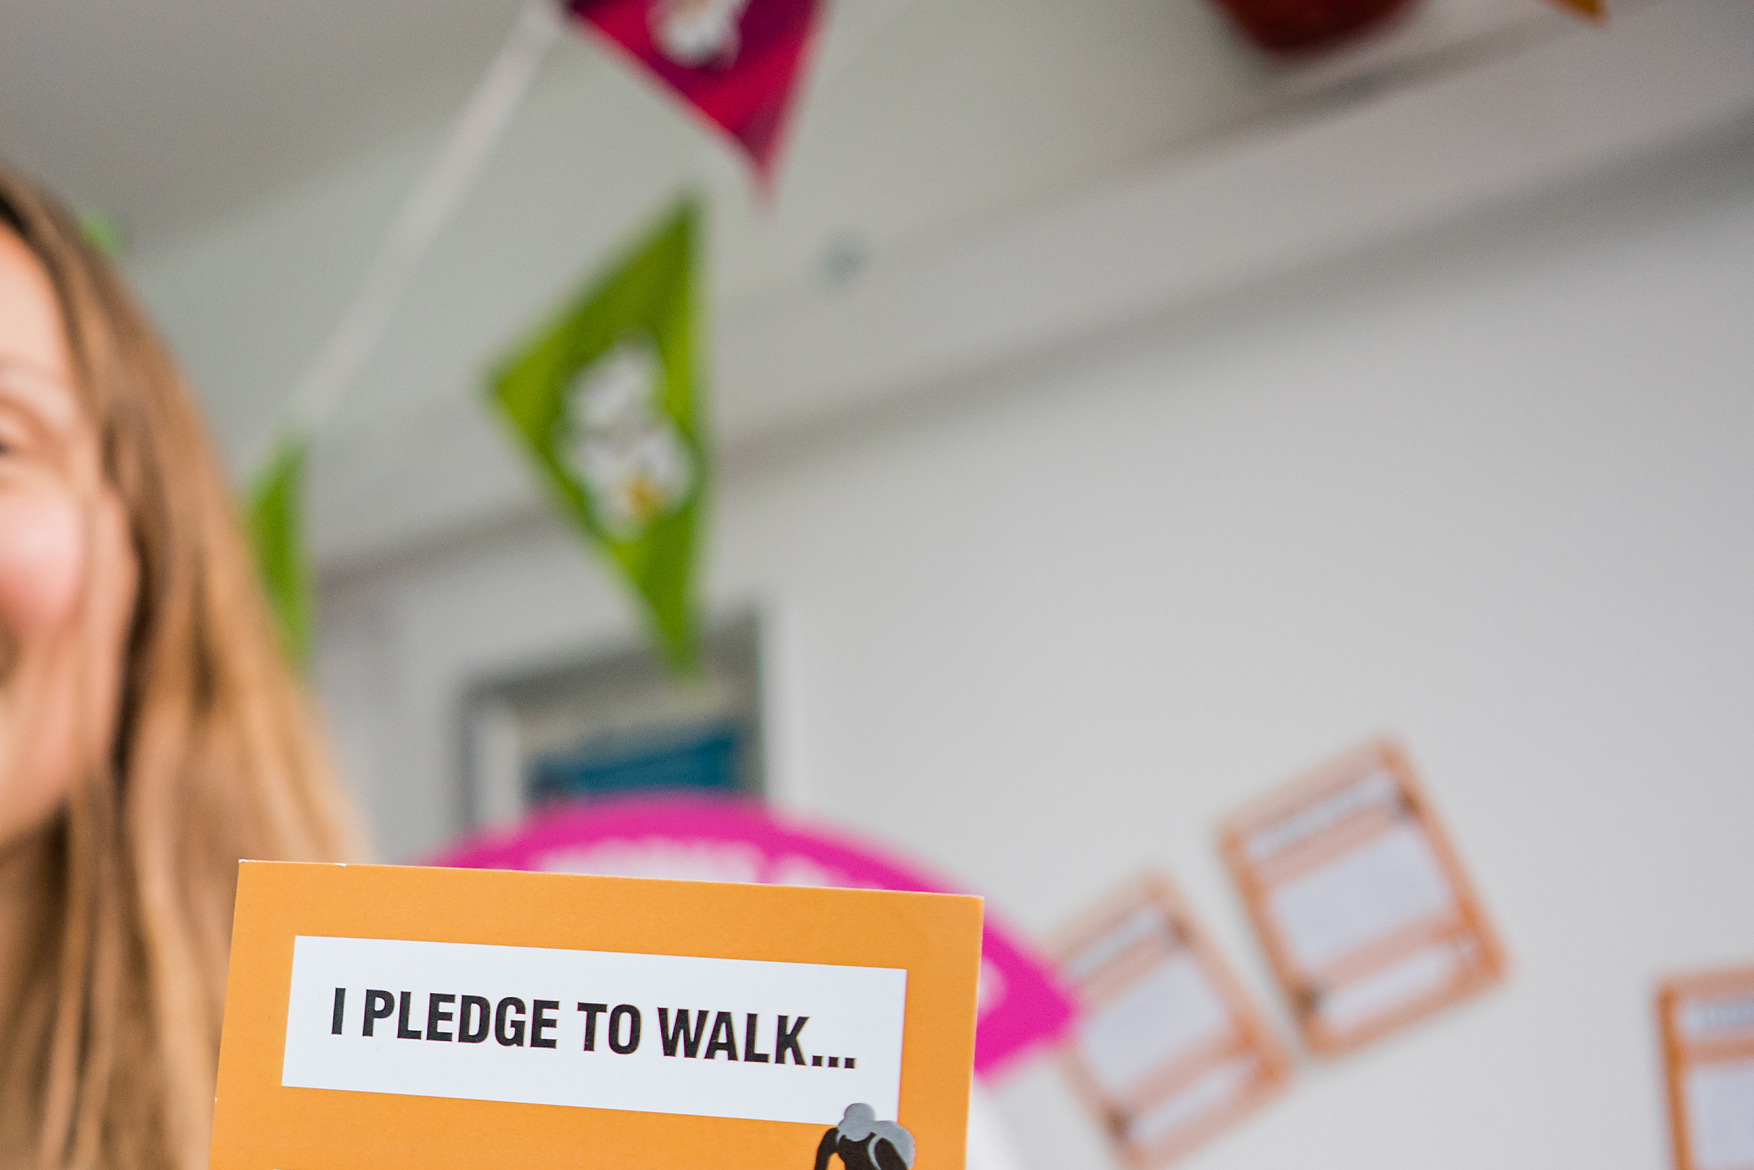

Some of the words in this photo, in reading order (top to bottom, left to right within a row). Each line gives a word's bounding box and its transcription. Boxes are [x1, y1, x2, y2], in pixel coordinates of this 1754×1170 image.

[331, 987, 347, 1035] I
[361, 988, 561, 1050] PLEDGE
[577, 1001, 642, 1056] TO
[657, 1006, 857, 1069] WALK...
